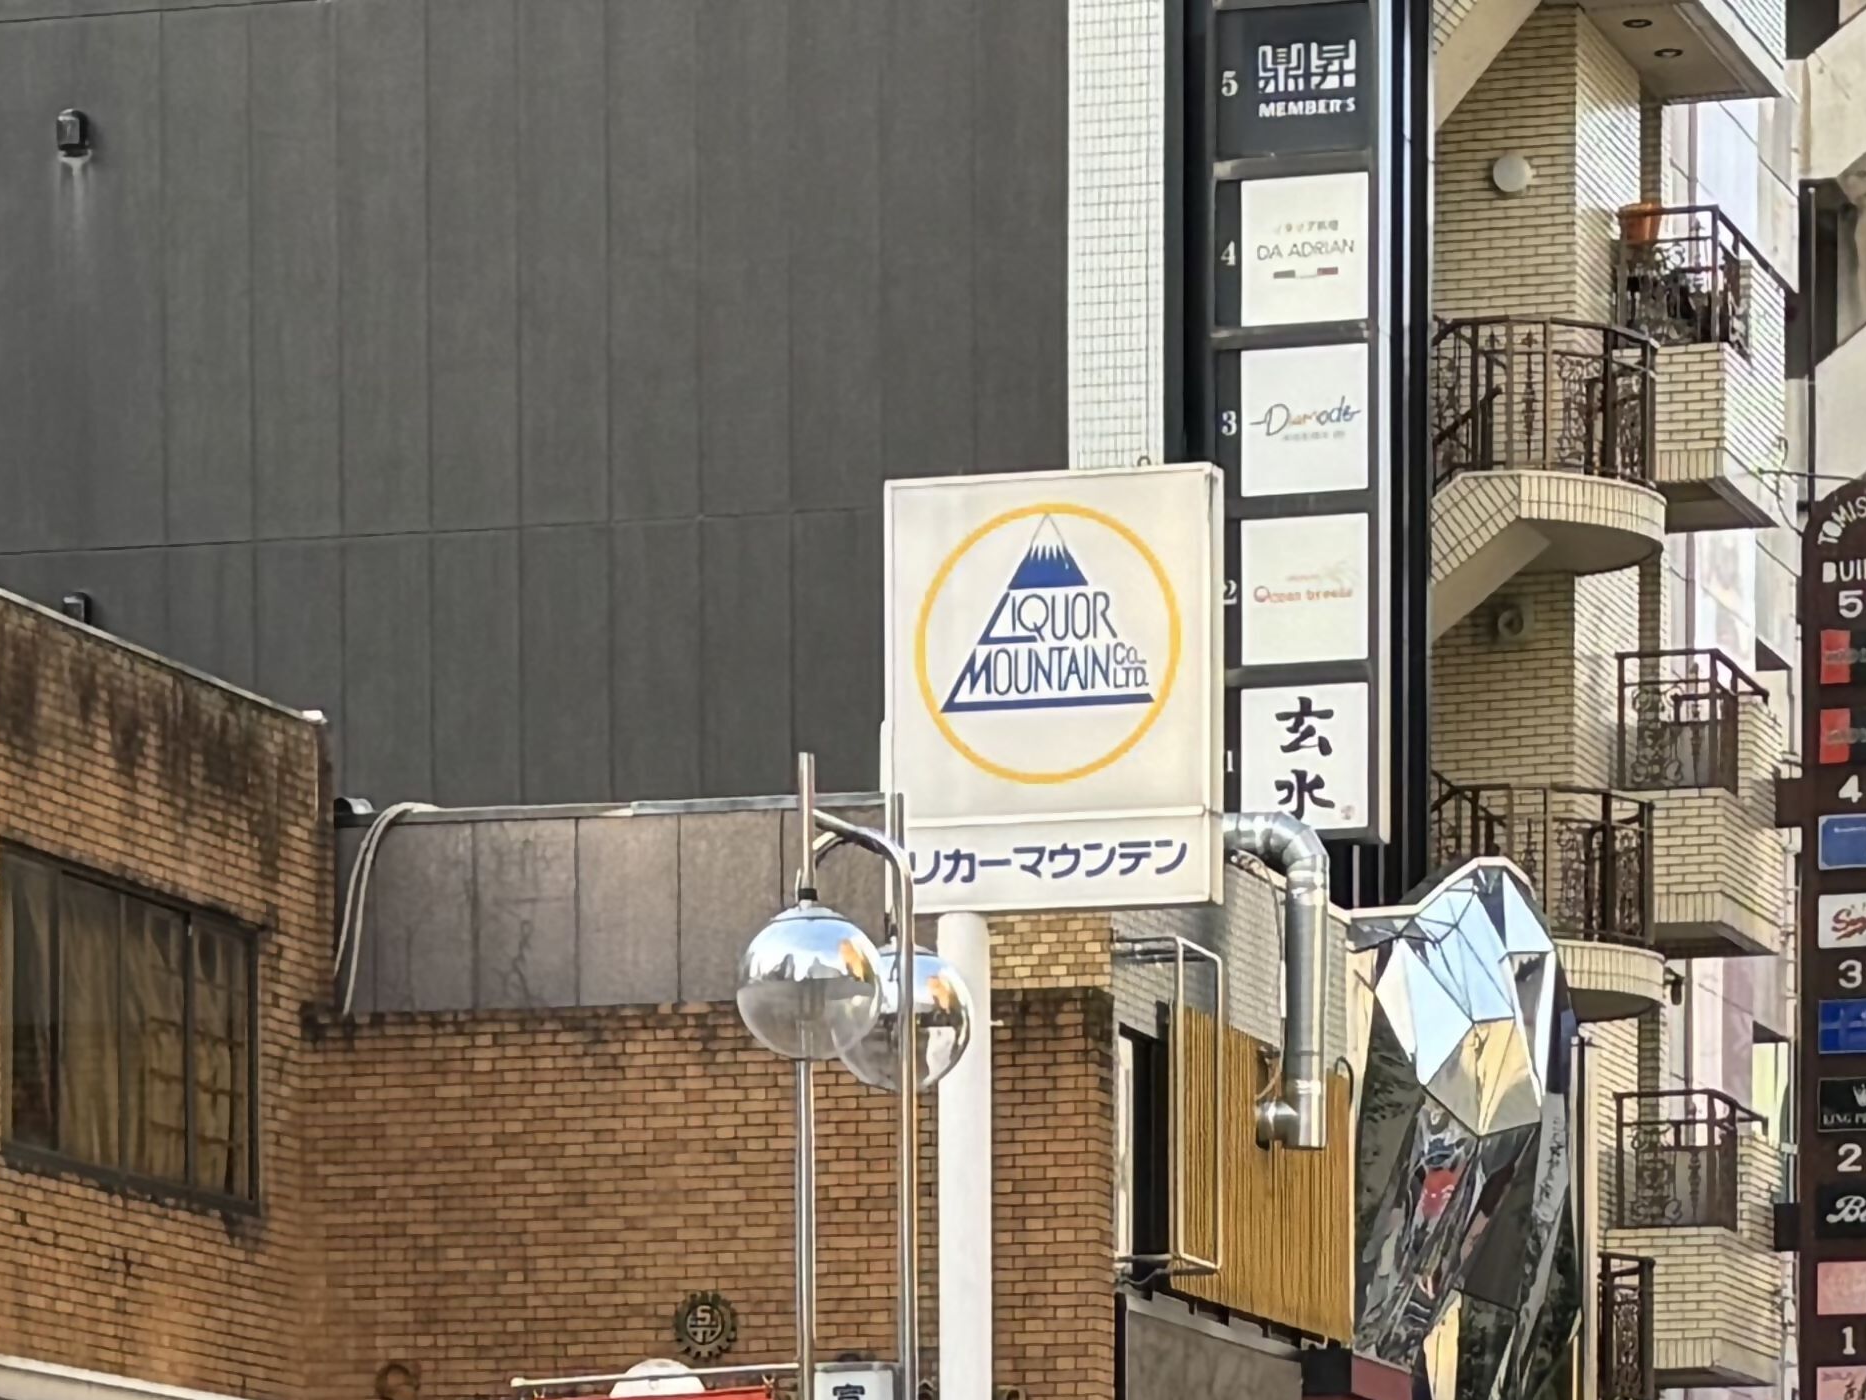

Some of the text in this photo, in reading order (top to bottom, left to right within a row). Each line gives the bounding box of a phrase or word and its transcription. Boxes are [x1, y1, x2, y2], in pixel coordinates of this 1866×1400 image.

[1221, 71, 1239, 97] 5
[1220, 240, 1237, 267] 4
[1220, 410, 1238, 436] 3
[977, 590, 1118, 646] LIQUOR
[945, 642, 1111, 700] MOUNTAIN
[1275, 695, 1335, 821] 玄水
[908, 839, 1188, 885] リカーマウンテン
